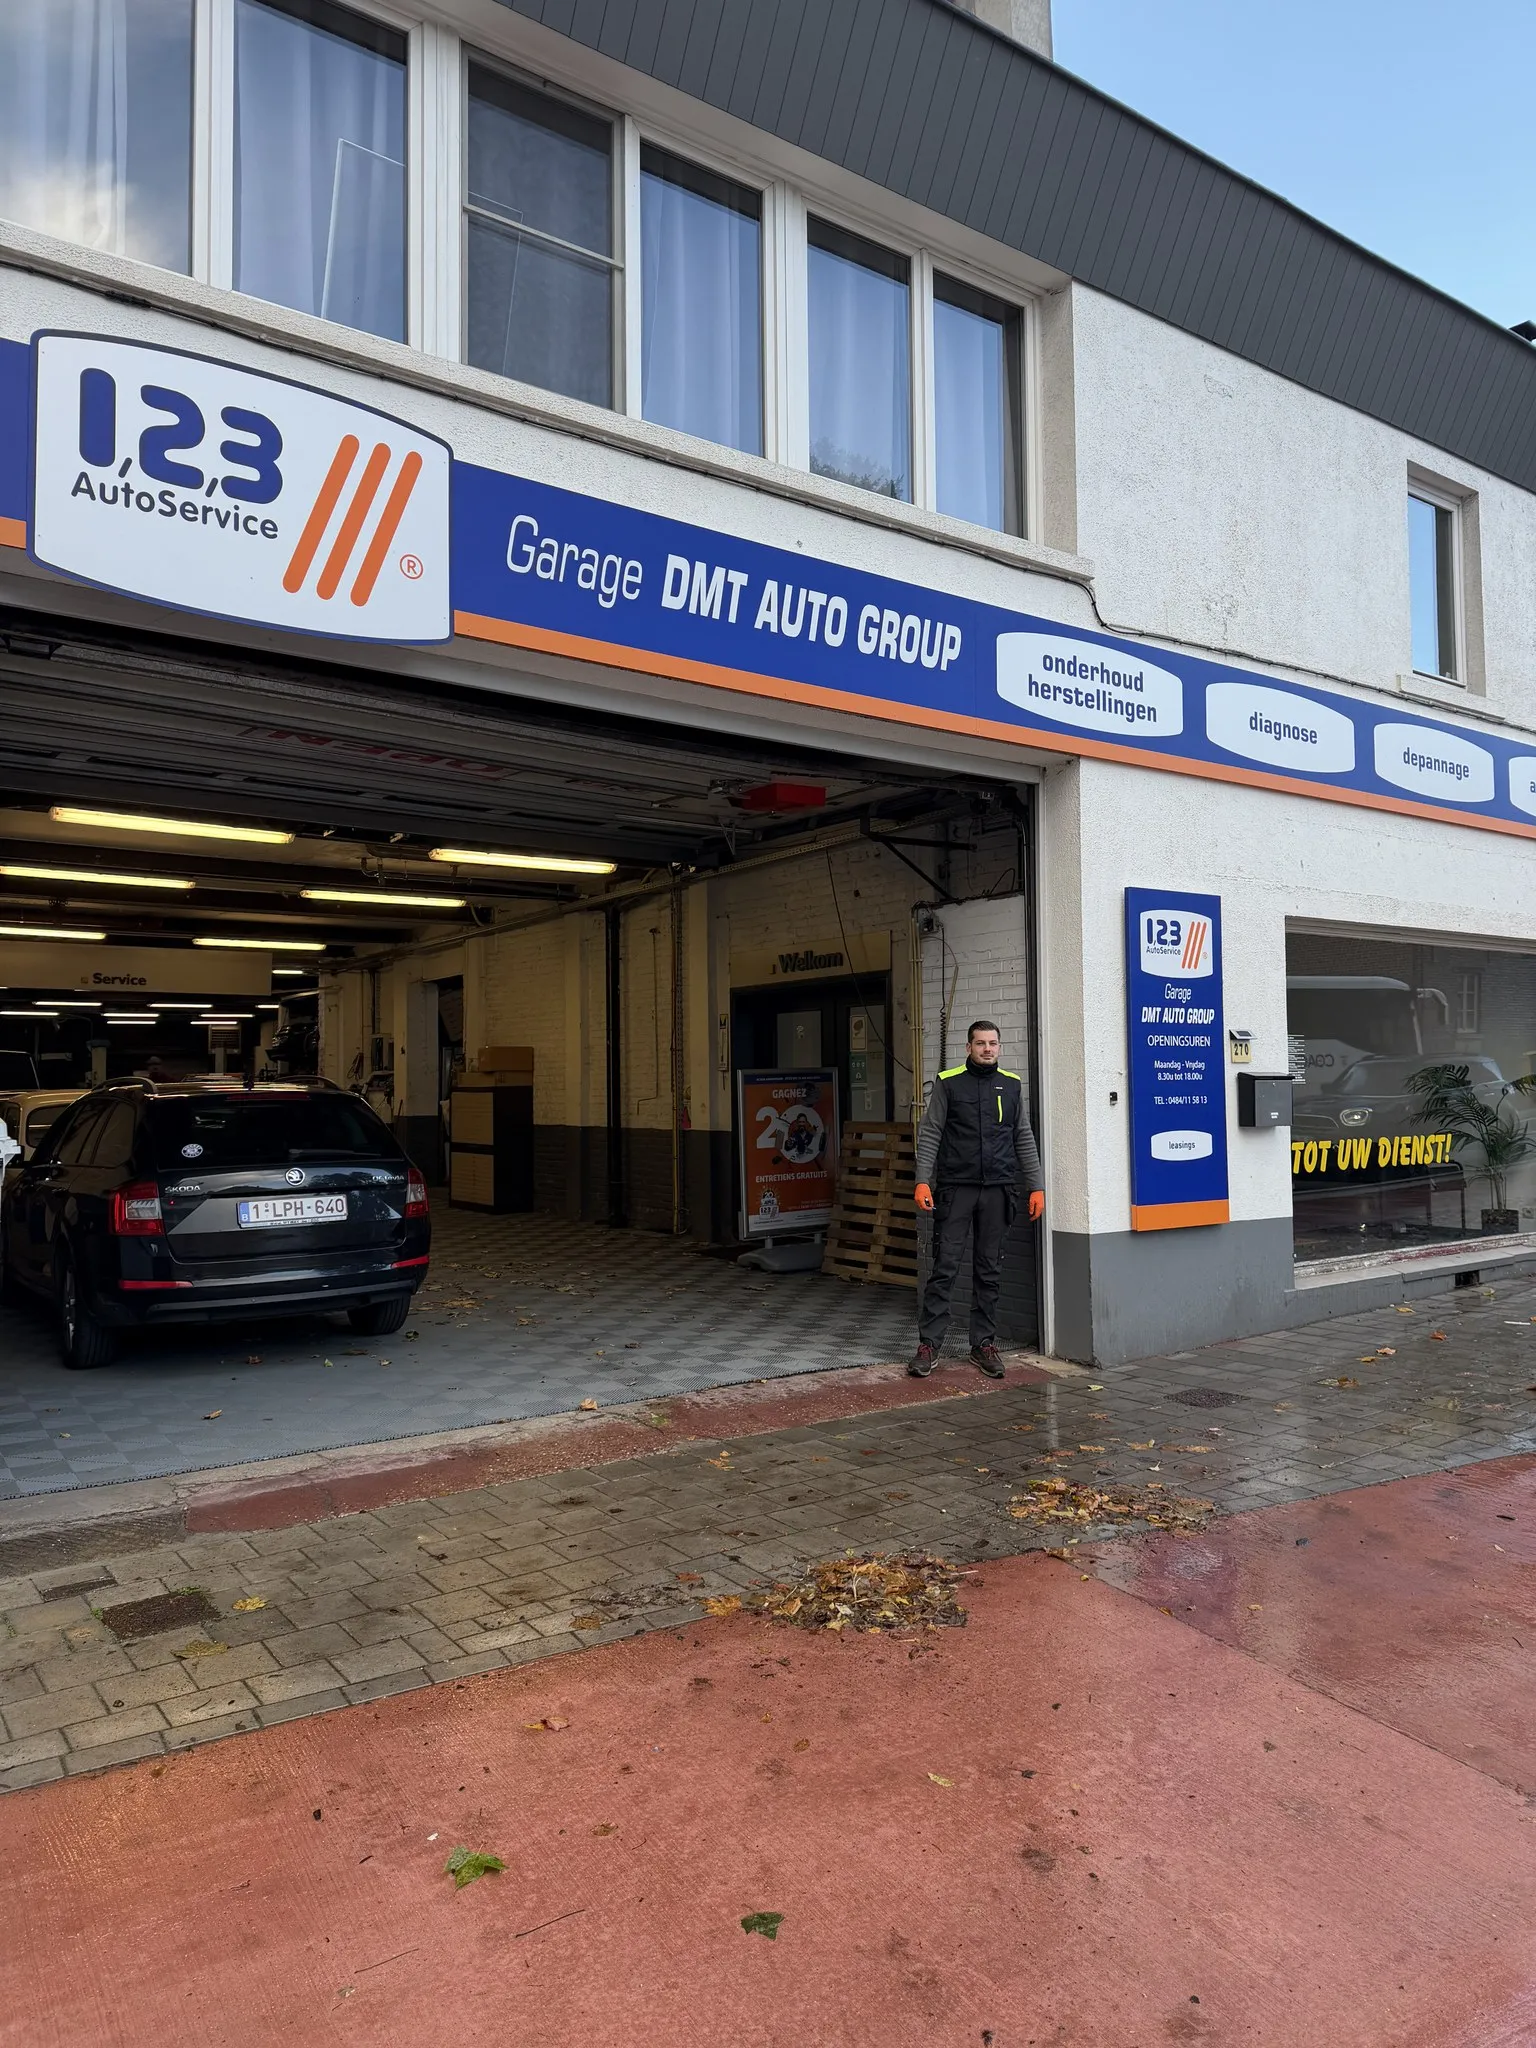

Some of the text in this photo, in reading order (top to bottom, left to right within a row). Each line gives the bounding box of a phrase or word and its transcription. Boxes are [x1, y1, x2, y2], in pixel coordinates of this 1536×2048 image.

[71, 471, 278, 539] AutoService
[506, 514, 962, 671] Garage DMT AUTO GROUP
[1042, 654, 1144, 692] onderhoud
[1028, 673, 1157, 723] herstellingen
[1249, 712, 1318, 744] diagnose
[1403, 747, 1469, 780] depannage
[1146, 946, 1181, 956] AutoService
[778, 950, 843, 973] Welkom
[93, 973, 147, 986] Service
[1165, 983, 1192, 1003] Garage
[1141, 1007, 1215, 1024] DMT AUTO GROUP
[1147, 1035, 1211, 1047] OPENINGSUREN
[1234, 1044, 1249, 1056] 270
[1154, 1060, 1181, 1070] Maandag
[1185, 1060, 1205, 1070] Vrijdag
[1157, 1072, 1203, 1081] 8.30u tot 18.00u
[772, 1088, 807, 1099] GAGNEZ
[1192, 1096, 1200, 1104] 58
[1201, 1096, 1208, 1104] 13
[1169, 1141, 1196, 1150] leasings
[1291, 1134, 1453, 1174] TOT UW DIENST!
[755, 1170, 828, 1183] ENTRETIENS GRATUITS
